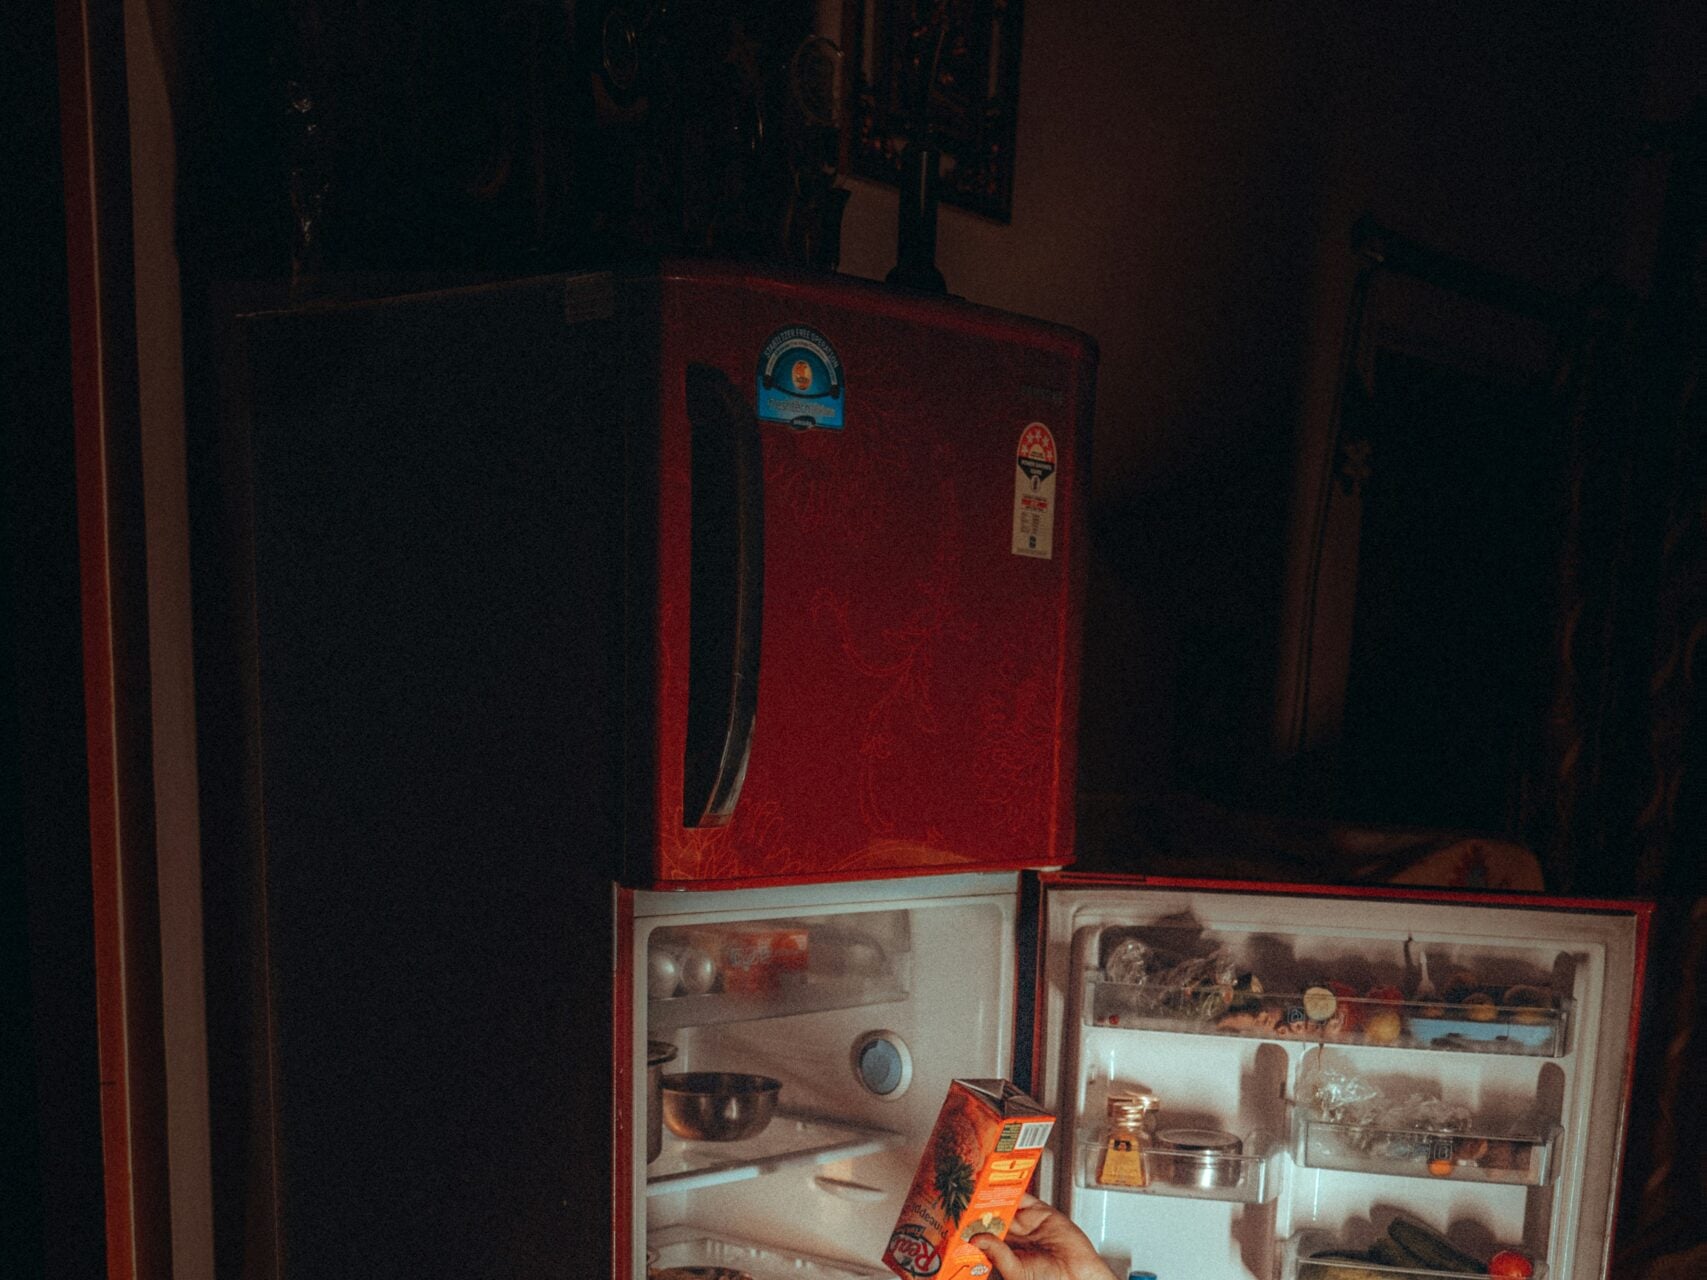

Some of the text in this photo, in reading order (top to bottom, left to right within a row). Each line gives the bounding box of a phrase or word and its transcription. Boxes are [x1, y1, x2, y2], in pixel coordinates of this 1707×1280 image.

[764, 329, 795, 357] STABILIZER
[796, 328, 811, 339] FREE
[891, 1238, 938, 1272] Real
